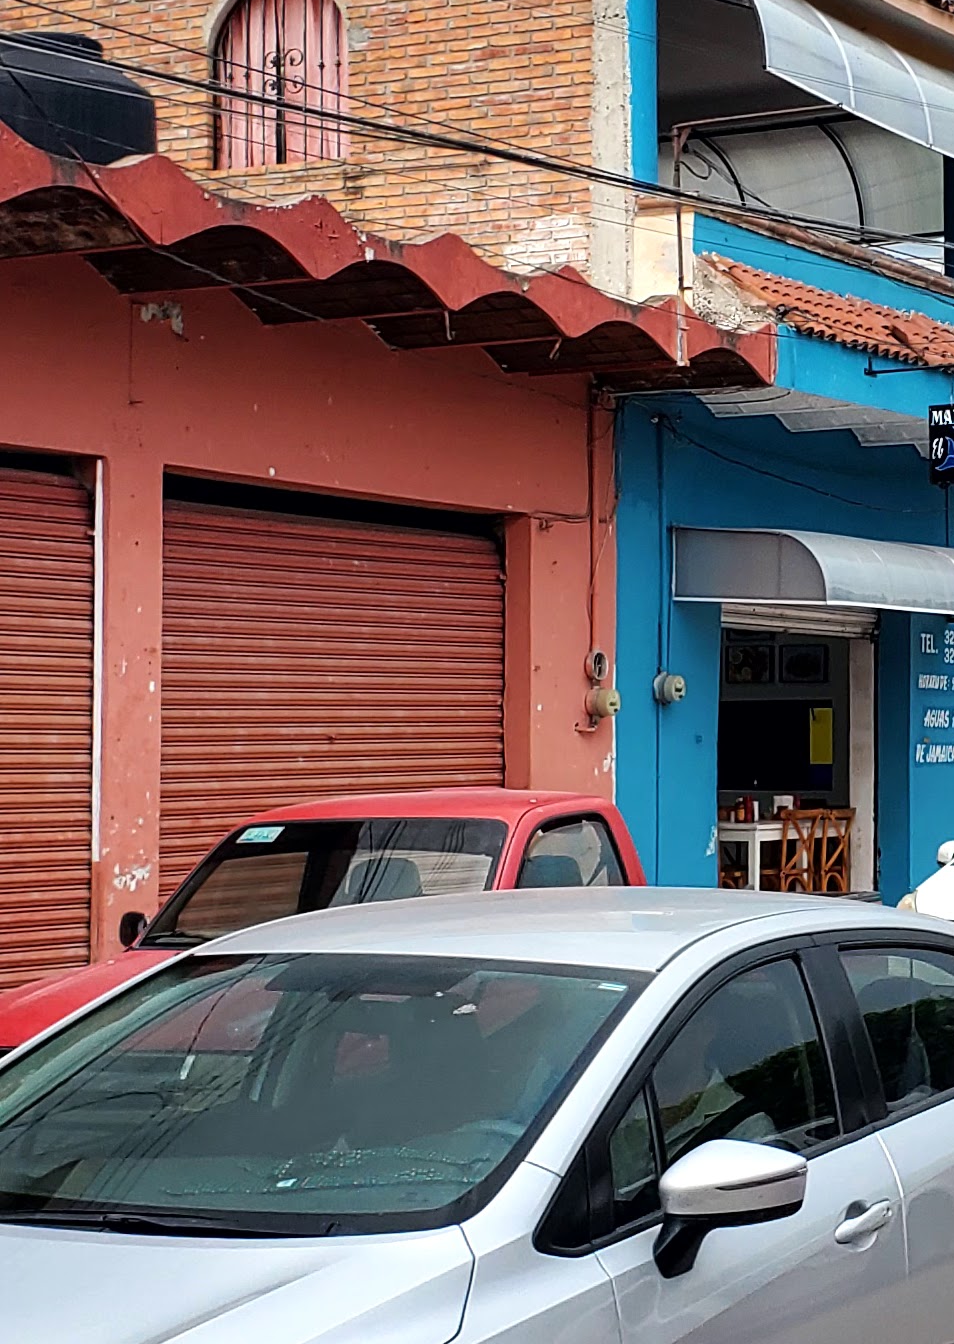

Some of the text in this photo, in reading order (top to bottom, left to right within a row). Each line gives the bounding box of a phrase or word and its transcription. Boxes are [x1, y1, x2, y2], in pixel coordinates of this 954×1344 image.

[920, 633, 938, 654] TEL.
[924, 709, 950, 728] AGUAS
[915, 743, 927, 763] DE
